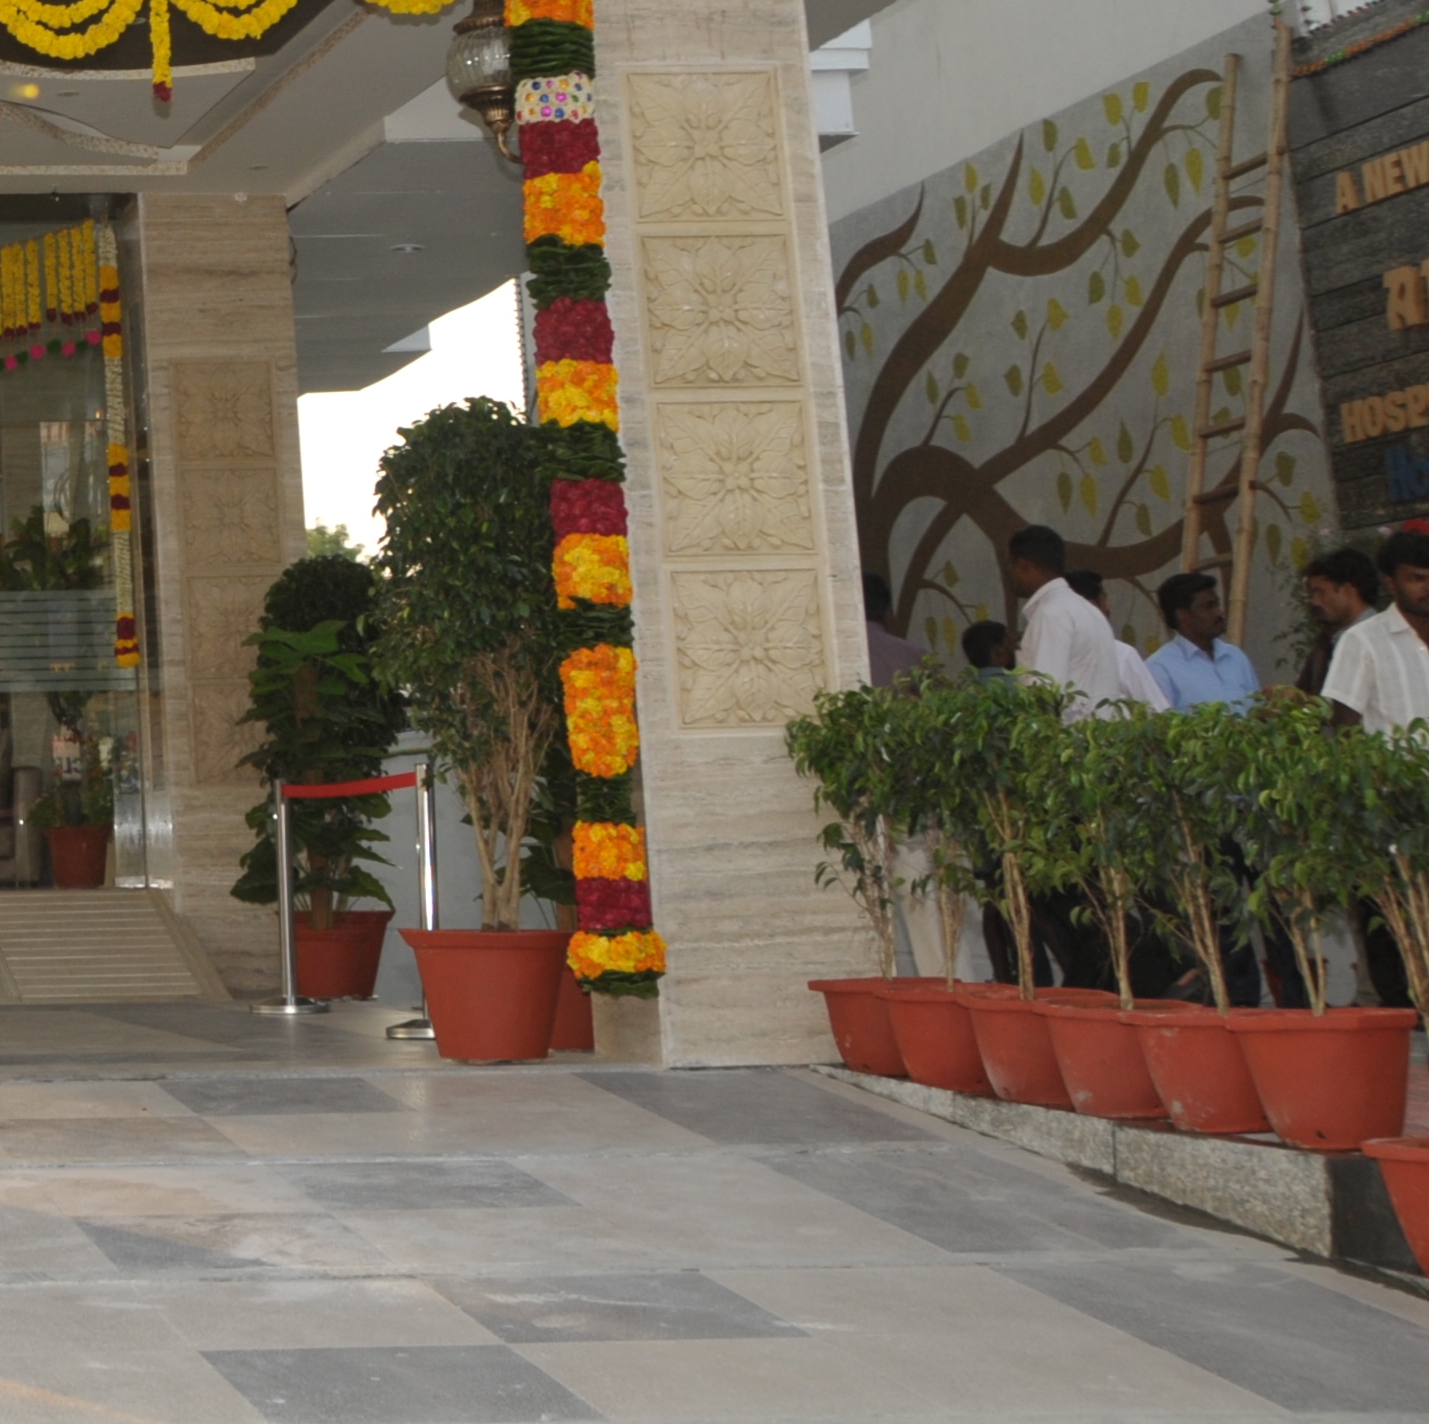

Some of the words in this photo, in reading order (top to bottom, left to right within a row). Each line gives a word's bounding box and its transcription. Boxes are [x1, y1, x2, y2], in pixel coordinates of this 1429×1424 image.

[1335, 169, 1360, 214] A
[1362, 139, 1429, 203] NEW
[1340, 382, 1429, 443] HOSP
